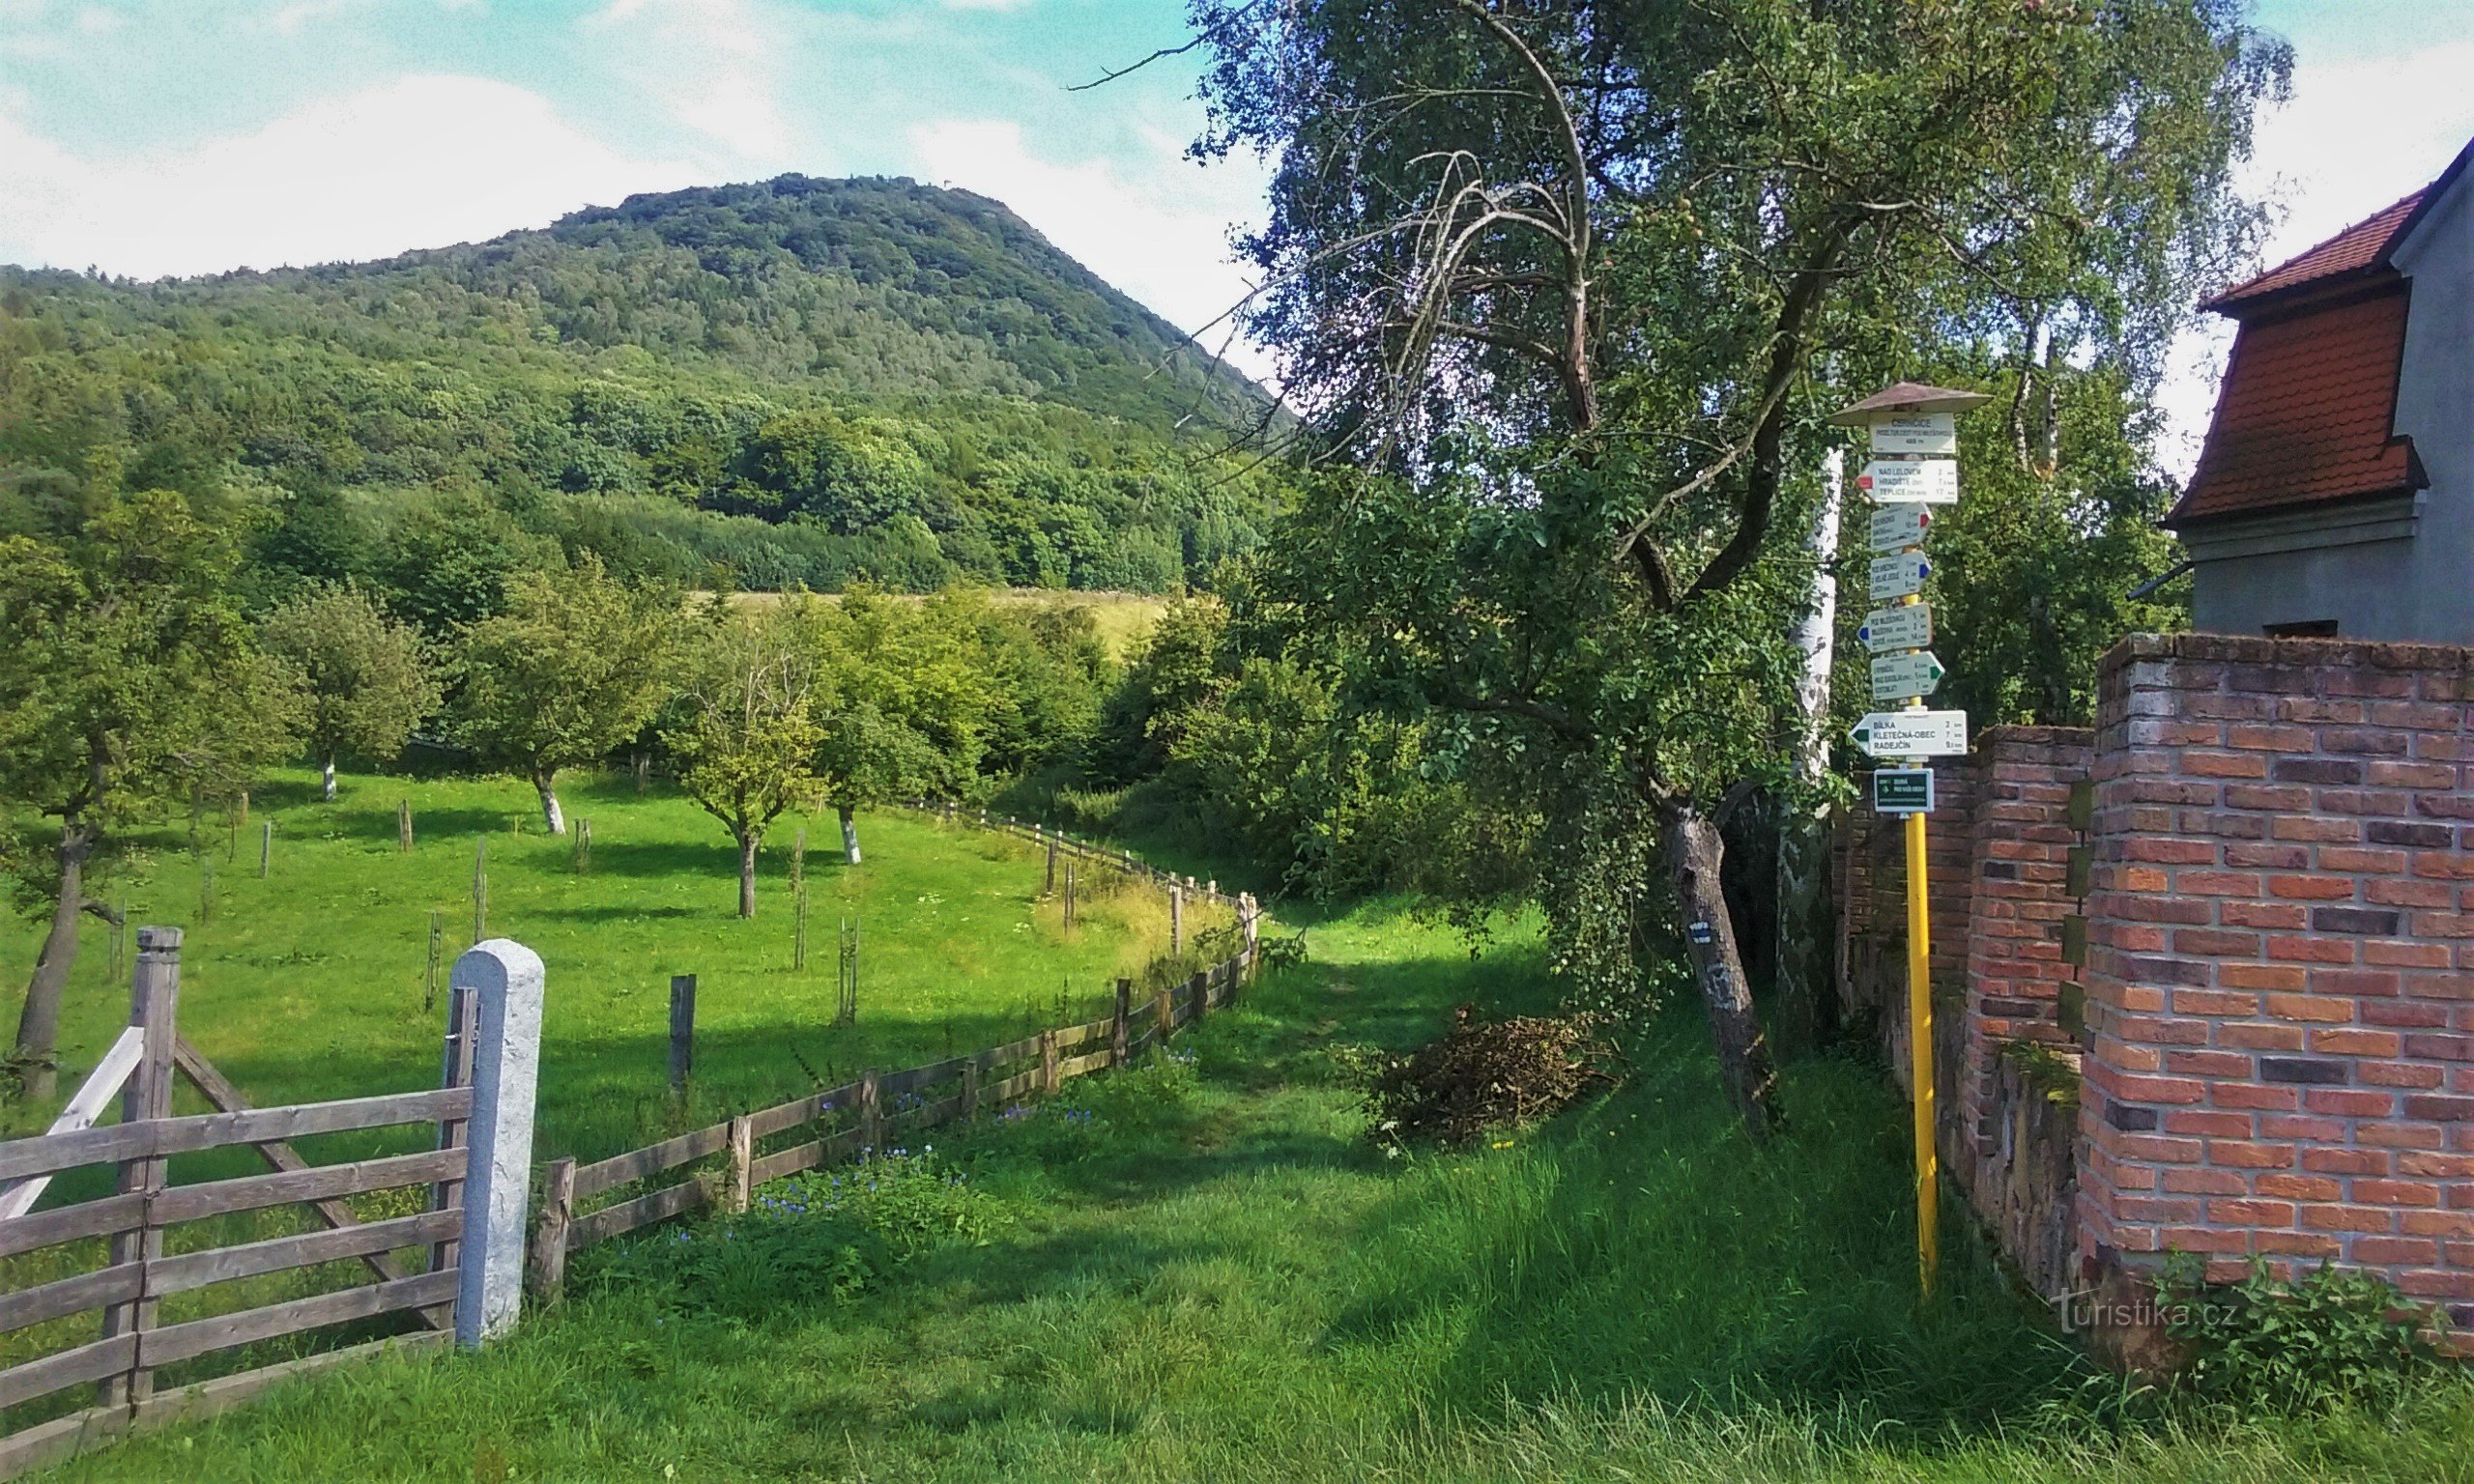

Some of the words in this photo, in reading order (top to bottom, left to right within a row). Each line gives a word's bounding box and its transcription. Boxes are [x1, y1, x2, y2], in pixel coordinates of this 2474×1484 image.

[1879, 487, 1906, 496] TEPLICE
[1873, 721, 1896, 729] BÍLKA
[1945, 720, 1950, 728] 2
[1873, 729, 1936, 740] KLETEČNÁ-OBEC
[1874, 740, 1912, 750] RADEJČÍN
